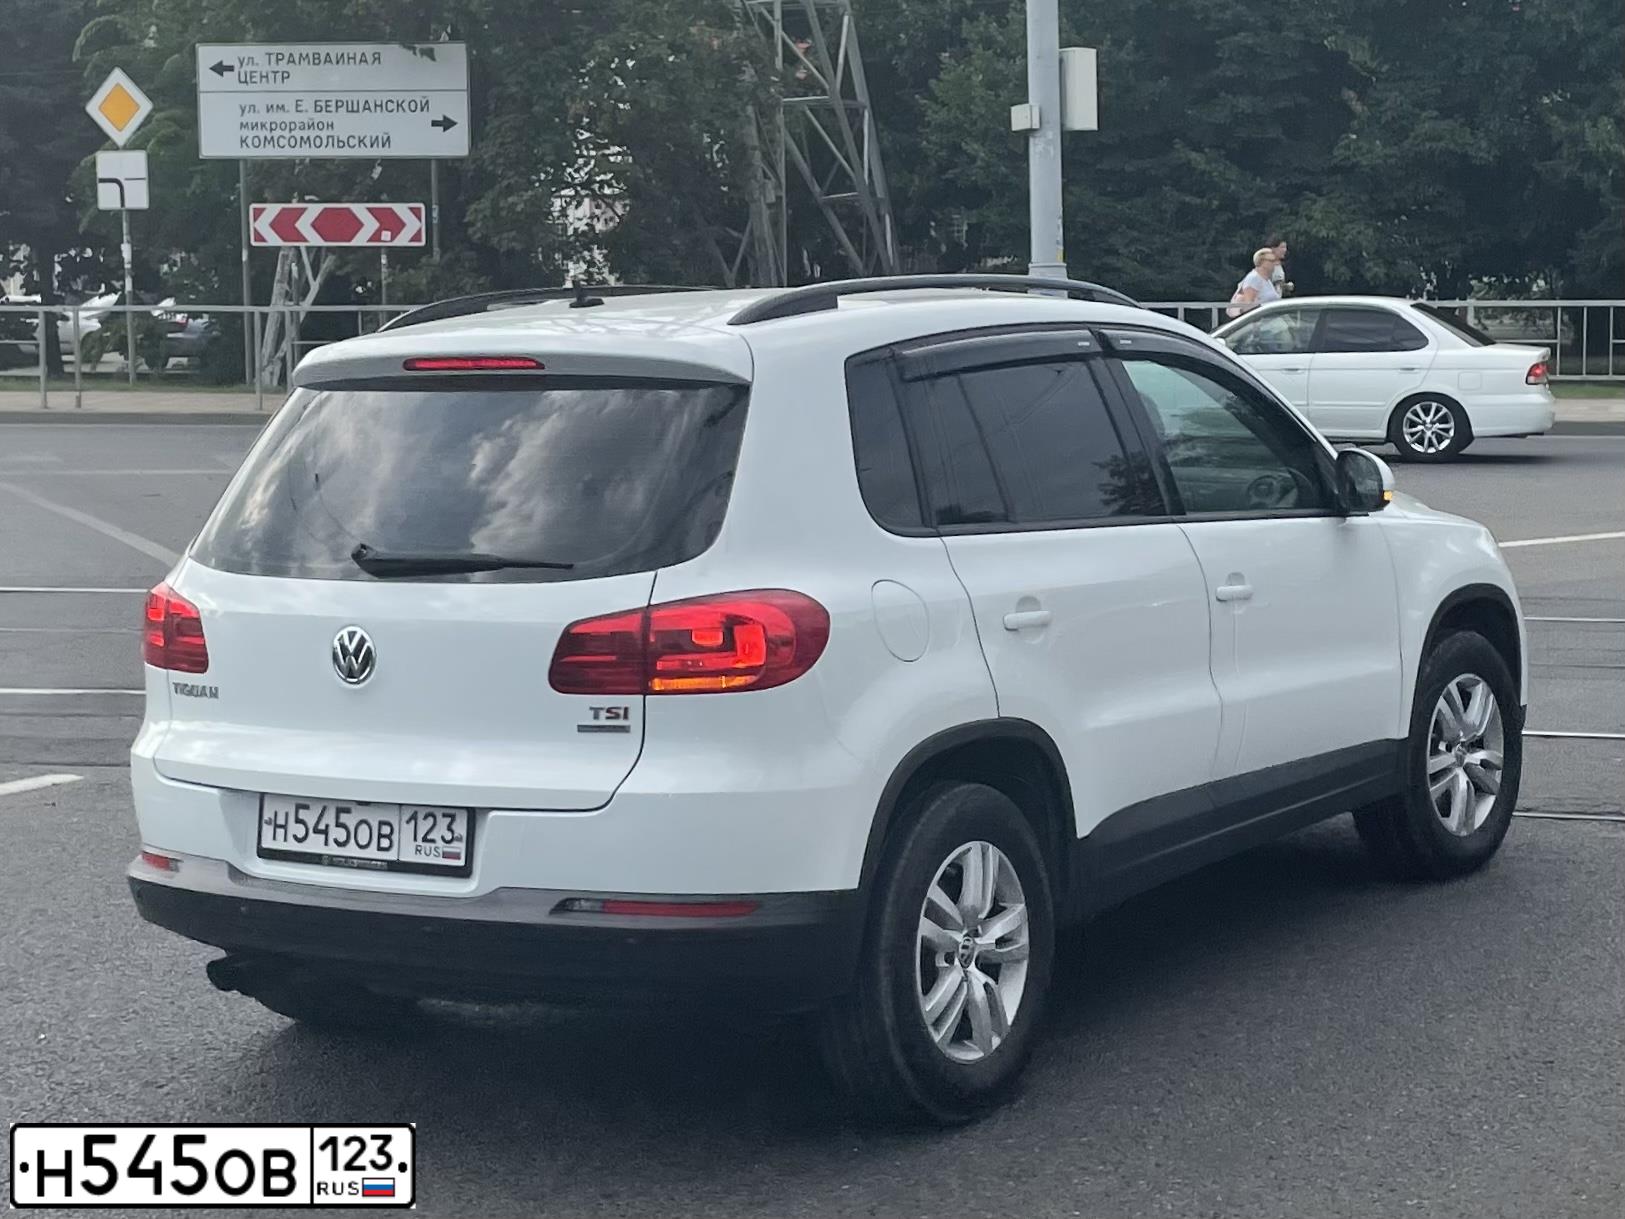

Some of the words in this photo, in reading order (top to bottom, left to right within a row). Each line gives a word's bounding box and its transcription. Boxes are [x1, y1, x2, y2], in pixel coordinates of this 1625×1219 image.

[237, 55, 260, 68] ул.
[237, 70, 291, 85] ЦЕНТР
[239, 103, 260, 117] ул.
[265, 103, 290, 113] им.
[295, 99, 308, 113] Е.
[314, 96, 430, 113] БЕРШАНСКОЙ
[239, 118, 335, 133] микрорайон
[239, 132, 392, 149] КОМСОМОЛЬСКИЙ
[589, 706, 629, 720] TSI
[405, 810, 456, 844] 123
[415, 844, 440, 857] RUS
